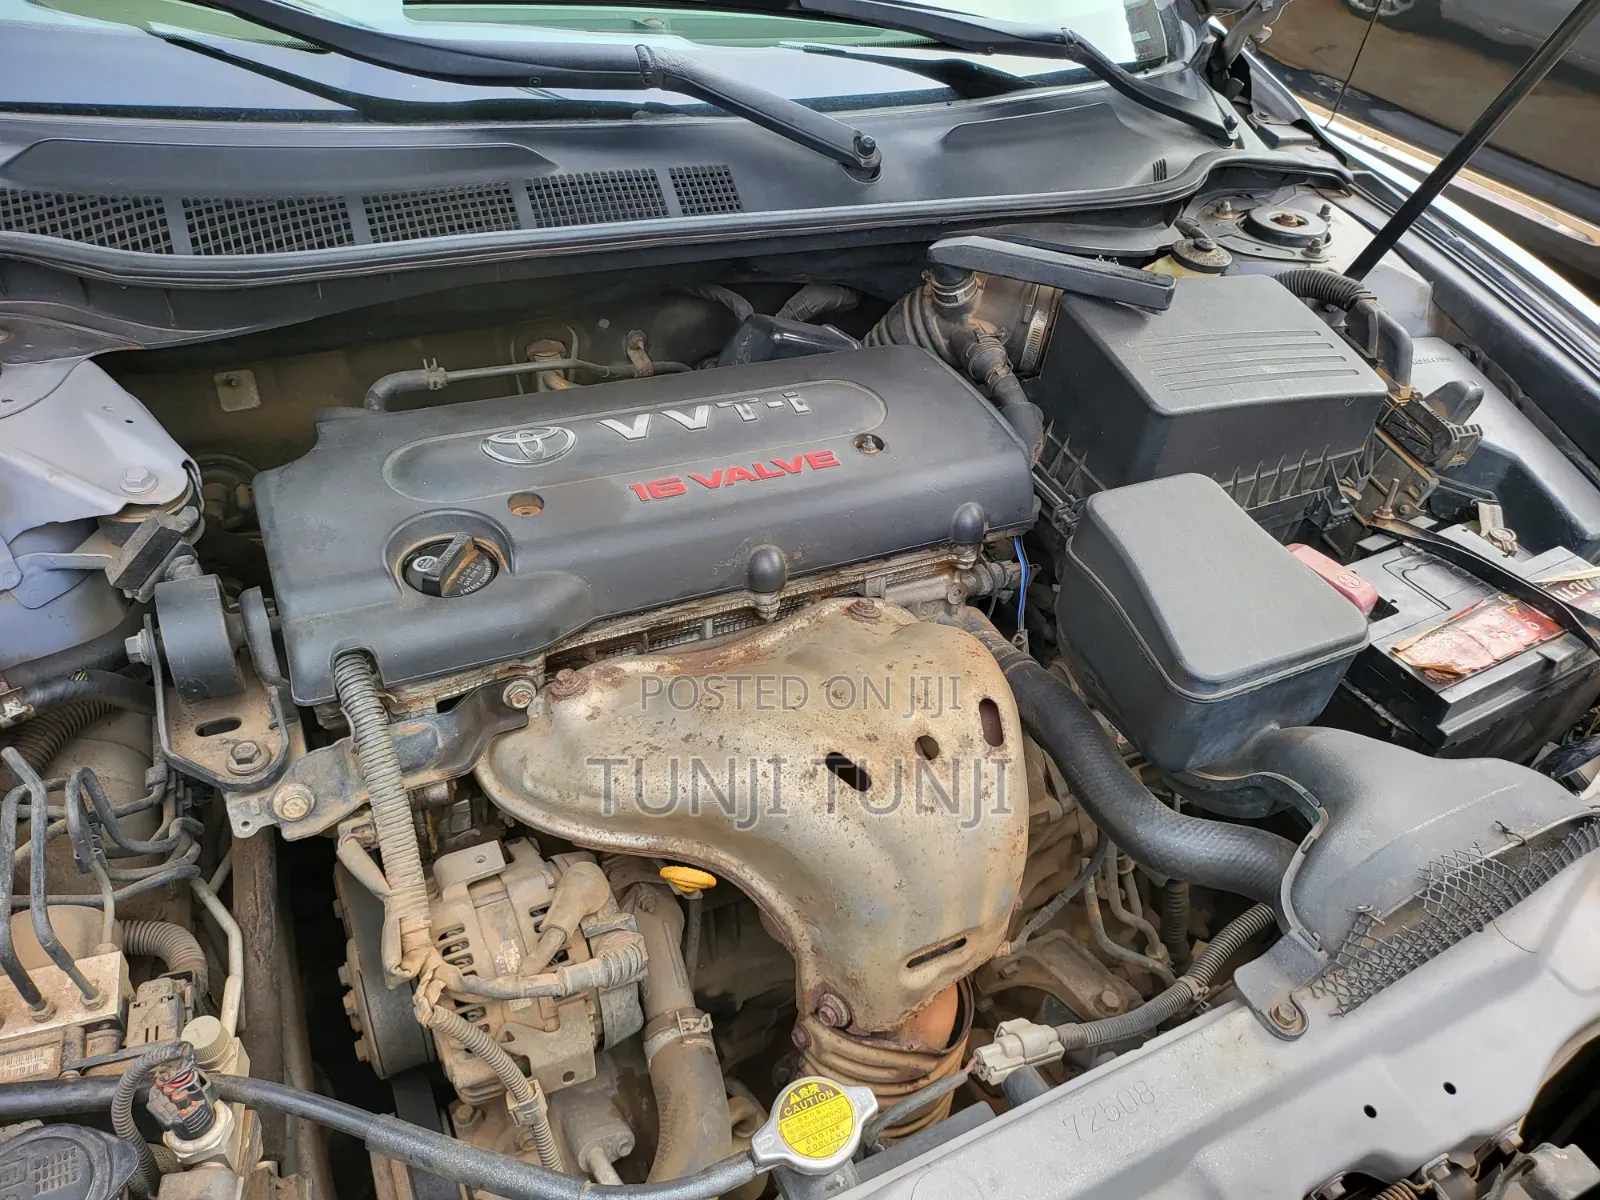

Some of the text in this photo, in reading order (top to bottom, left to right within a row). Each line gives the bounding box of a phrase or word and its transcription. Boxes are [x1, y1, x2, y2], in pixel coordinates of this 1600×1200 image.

[597, 391, 812, 441] VVT-i
[628, 449, 842, 502] 16 VALVE
[783, 1089, 834, 1116] CAUTION
[805, 1125, 841, 1145] ENGINE
[806, 1130, 847, 1153] COOLANT
